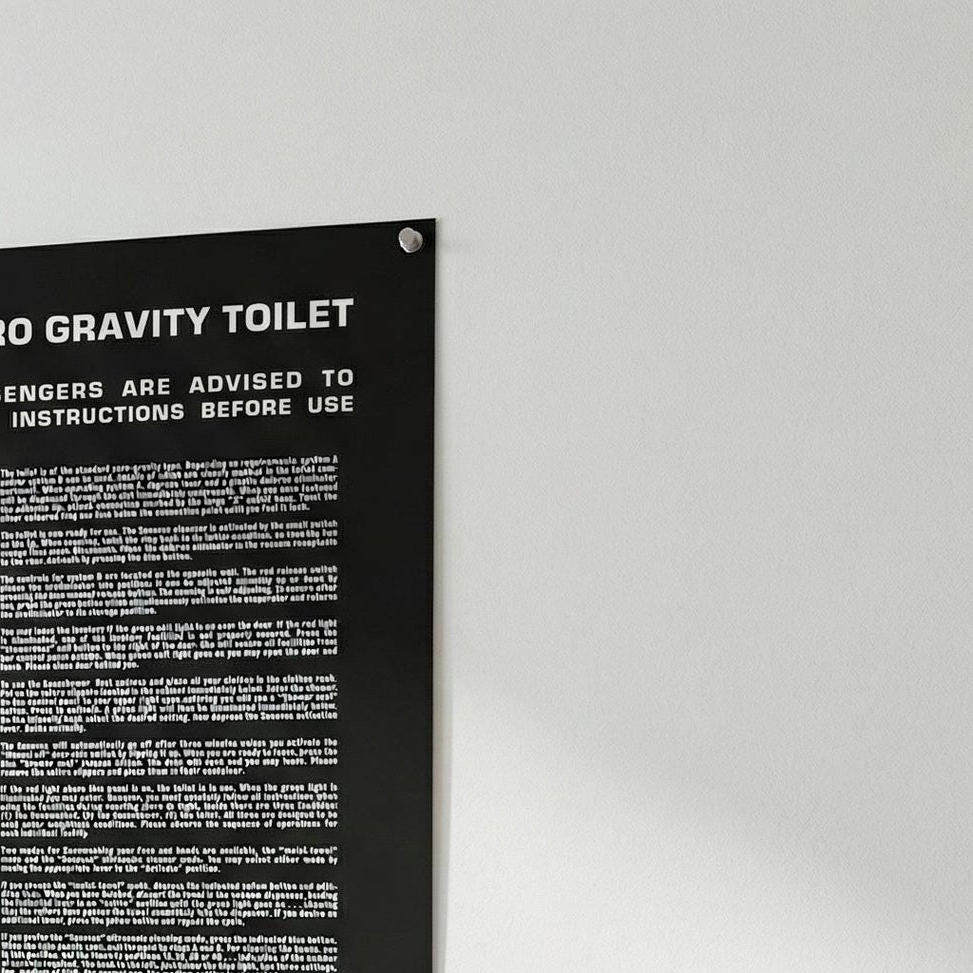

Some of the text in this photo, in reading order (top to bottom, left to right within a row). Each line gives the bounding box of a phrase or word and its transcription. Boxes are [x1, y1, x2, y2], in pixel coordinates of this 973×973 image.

[46, 307, 210, 343] GRAVITY
[222, 298, 354, 333] TOILET
[122, 378, 170, 397] ARE
[189, 372, 301, 393] ADVISED
[322, 369, 353, 386] TO
[13, 404, 184, 428] INSTRUCTIONS
[202, 398, 291, 418] BEFORE
[308, 396, 353, 413] USE
